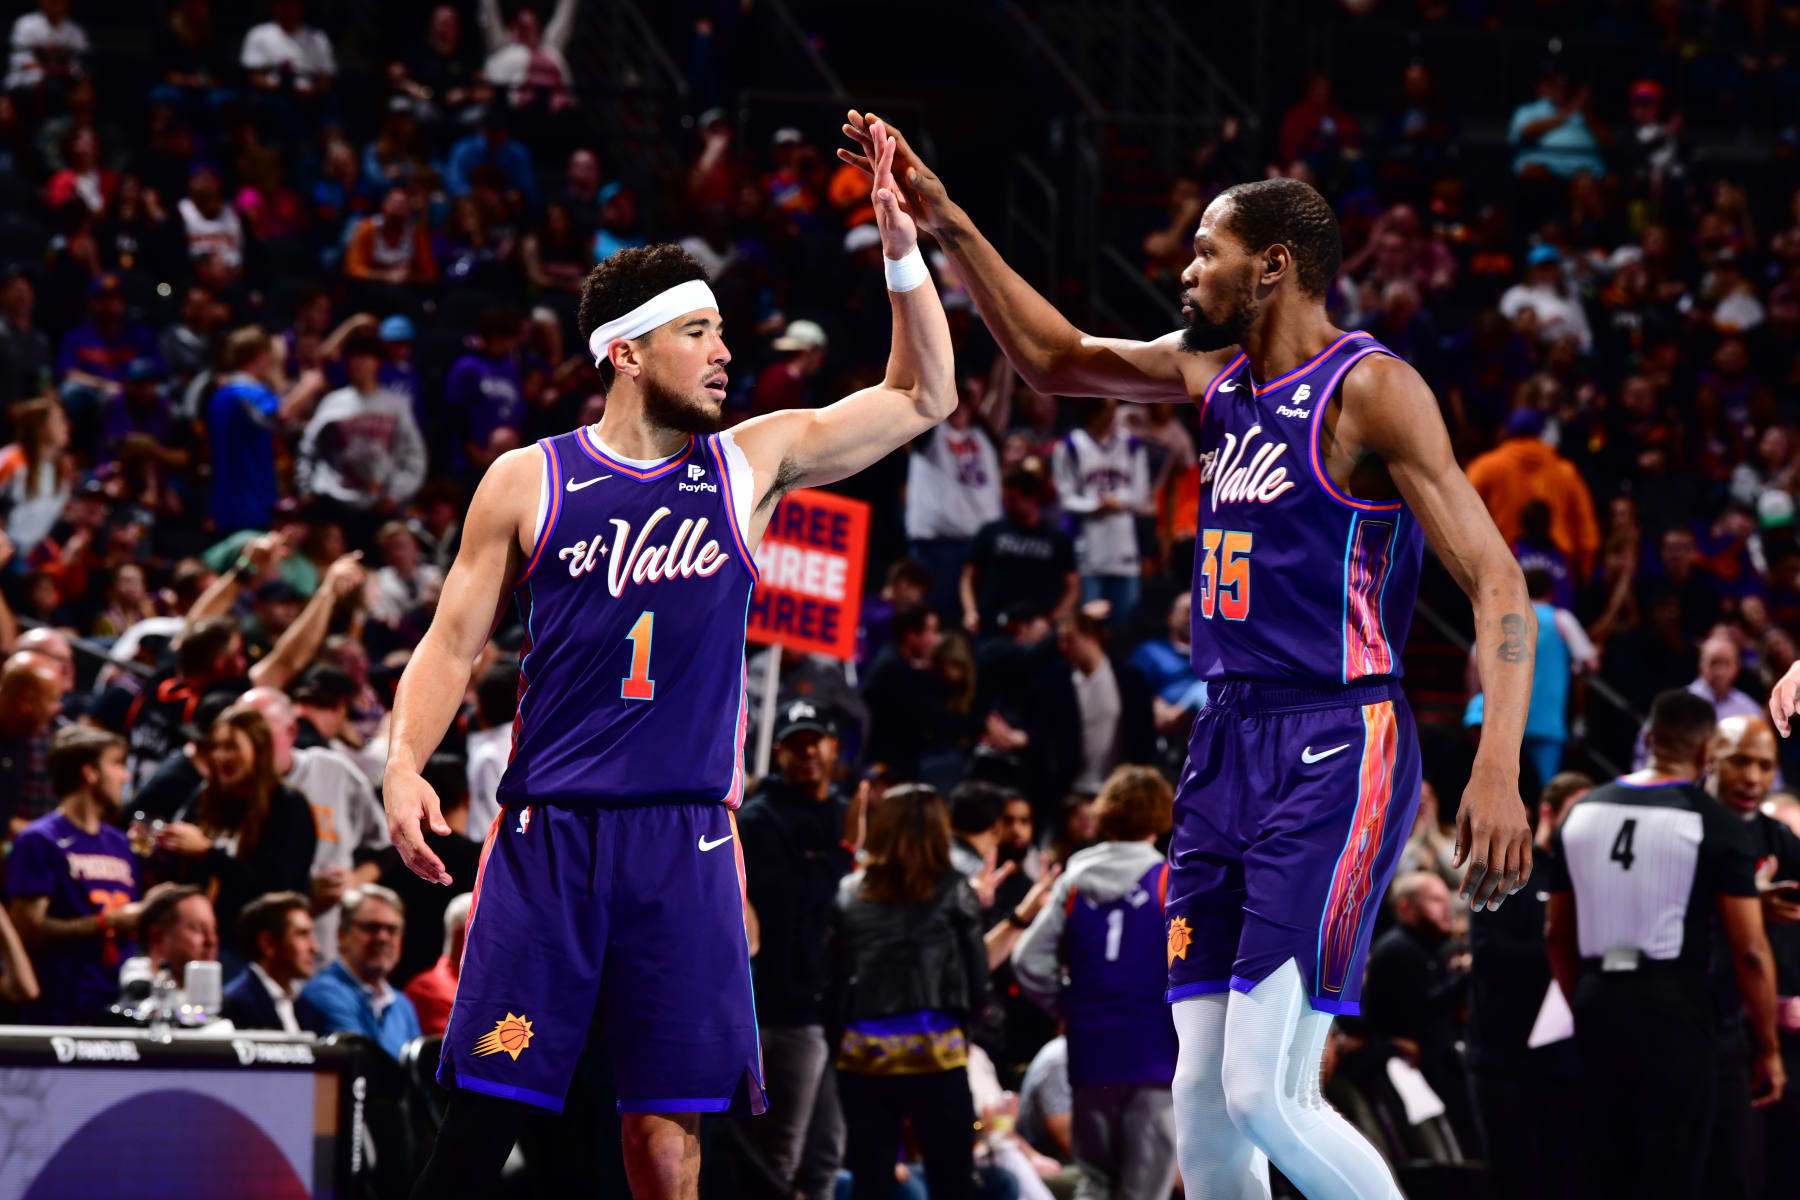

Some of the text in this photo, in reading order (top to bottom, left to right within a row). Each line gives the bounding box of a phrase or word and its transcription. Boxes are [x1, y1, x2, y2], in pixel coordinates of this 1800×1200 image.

[1276, 405, 1311, 419] PayPal
[678, 482, 717, 493] PayPal
[1211, 425, 1295, 513] Valle
[558, 506, 730, 598] El Valle
[770, 501, 851, 552] REE
[753, 541, 849, 604] HREE
[1200, 528, 1253, 622] 35
[747, 590, 840, 644] HREE
[620, 610, 655, 701] 1
[1610, 818, 1637, 871] 4
[1105, 908, 1124, 961] 1
